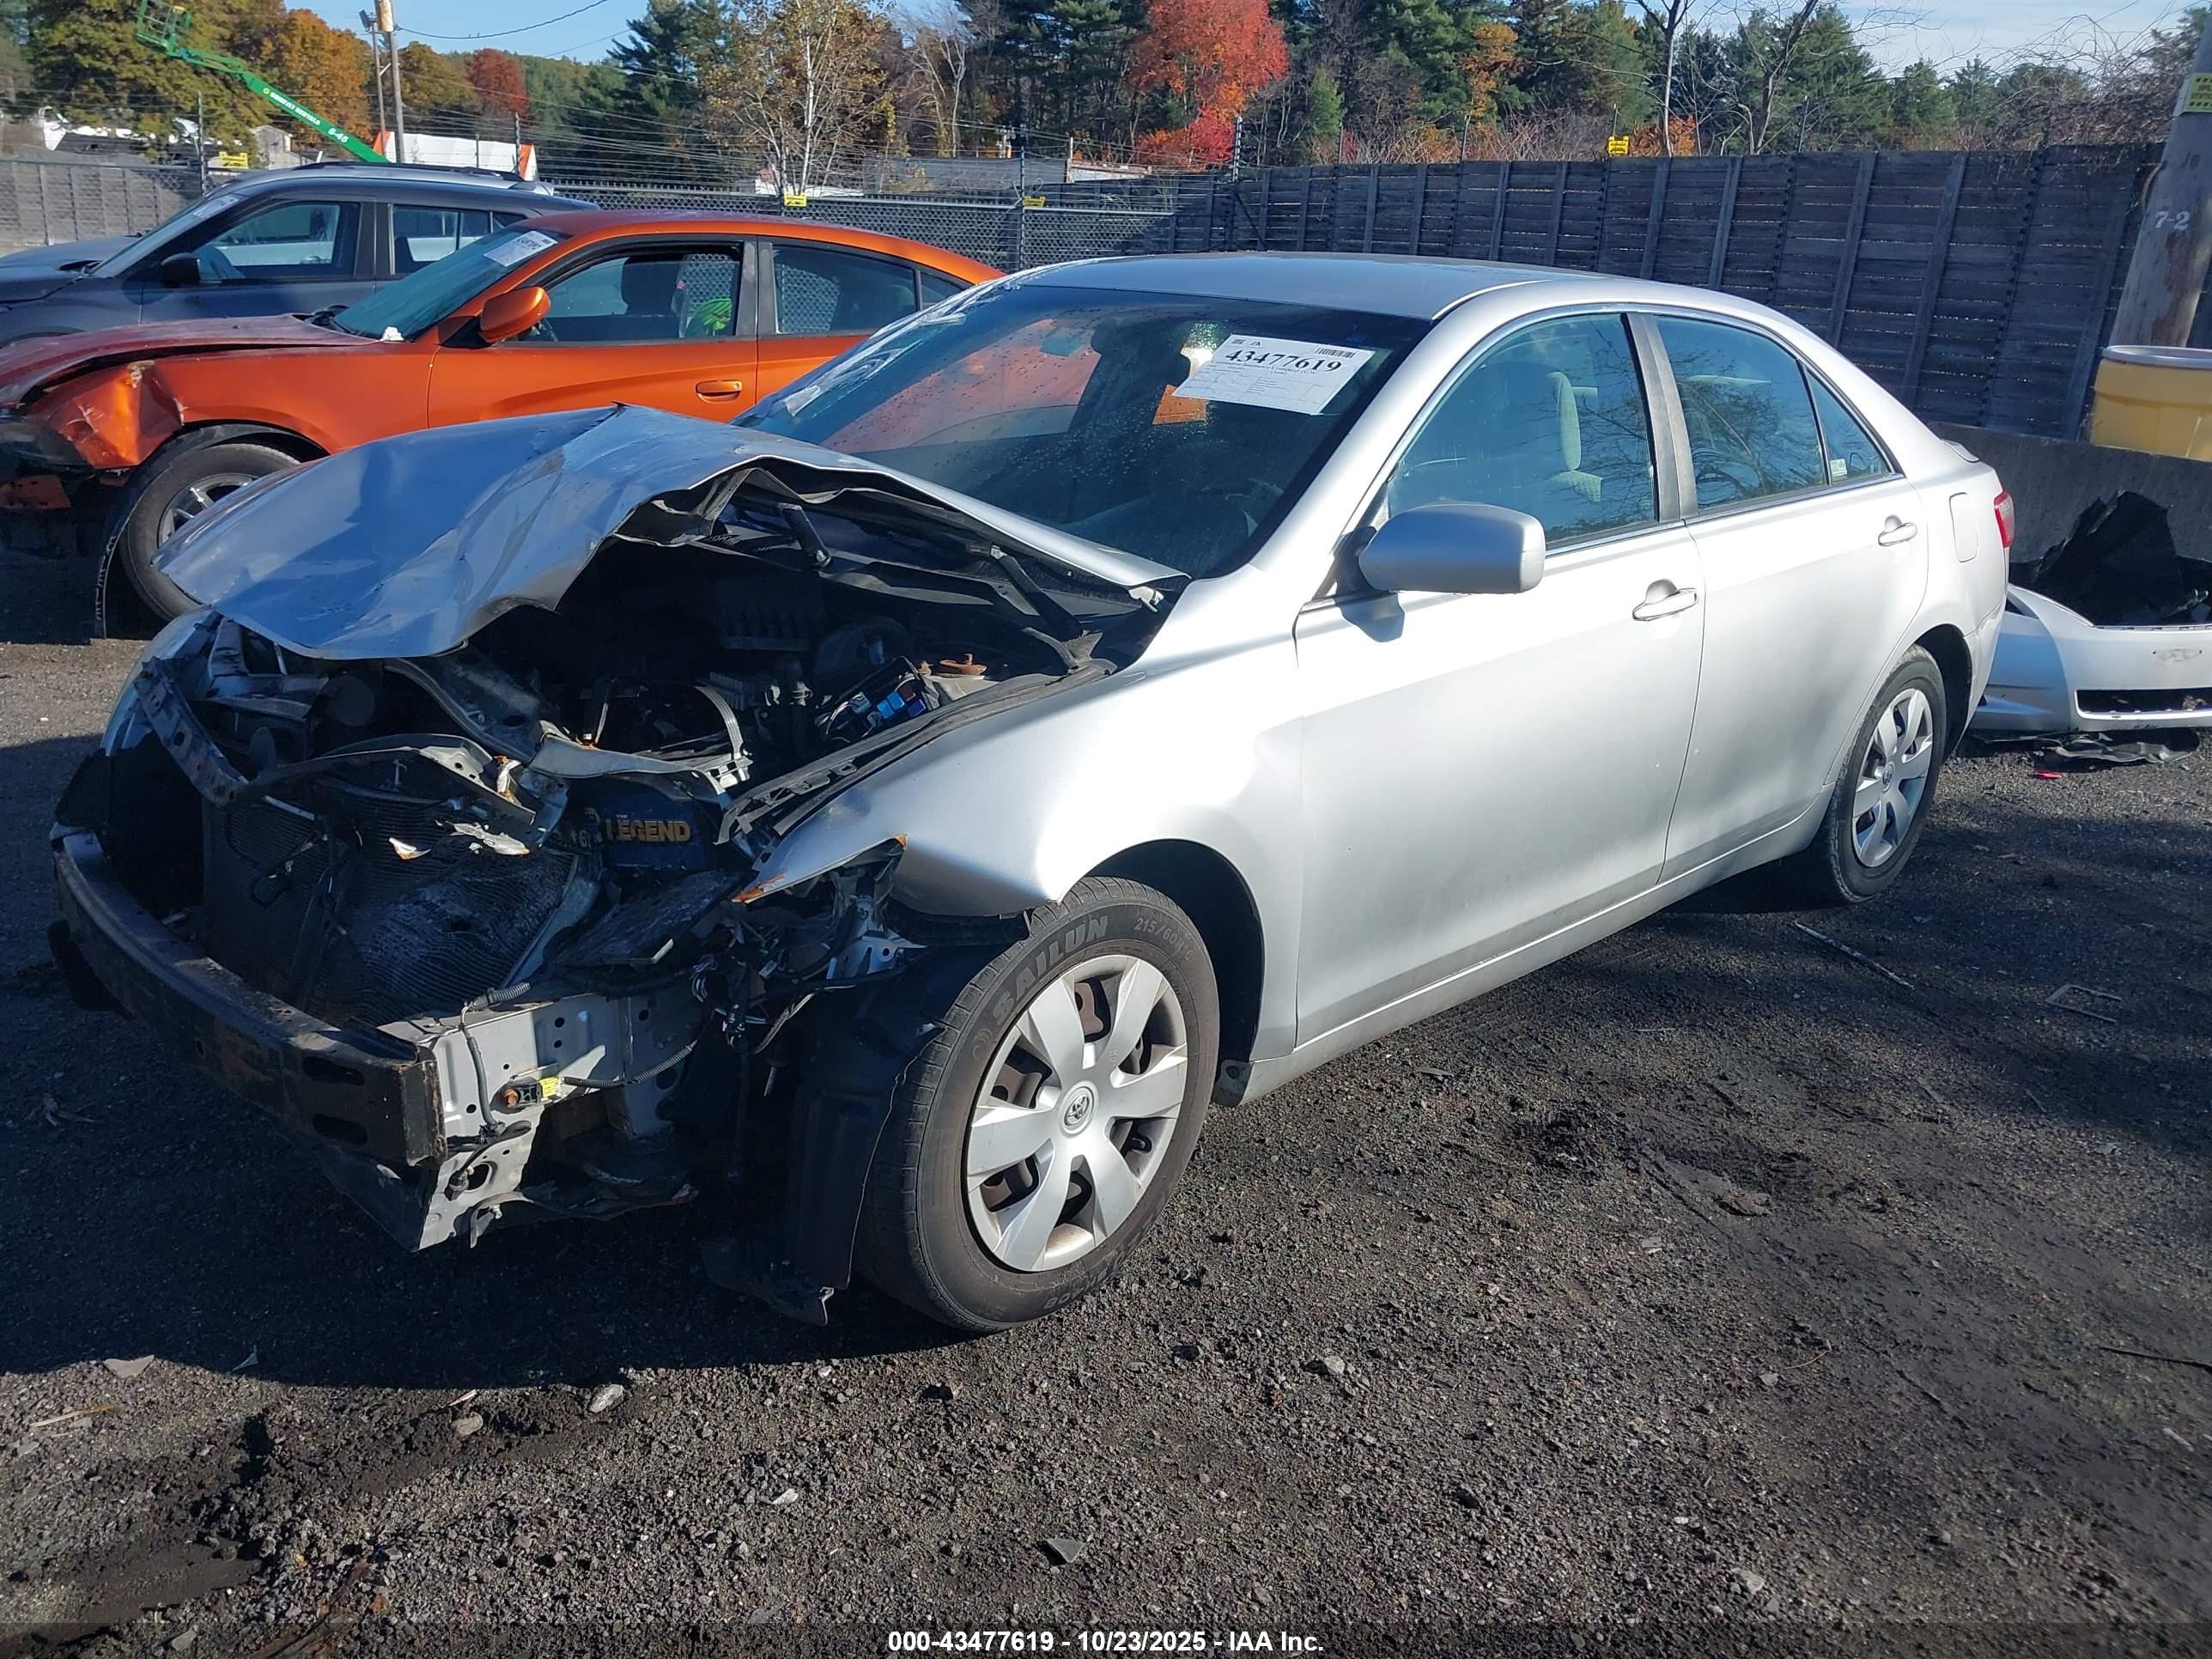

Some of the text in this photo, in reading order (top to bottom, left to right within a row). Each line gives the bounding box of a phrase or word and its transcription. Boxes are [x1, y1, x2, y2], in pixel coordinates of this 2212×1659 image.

[2155, 210, 2190, 230] 7-2
[1225, 349, 1341, 372] 43477619
[605, 819, 691, 842] LEGEND
[993, 915, 1109, 1026] SAILUN
